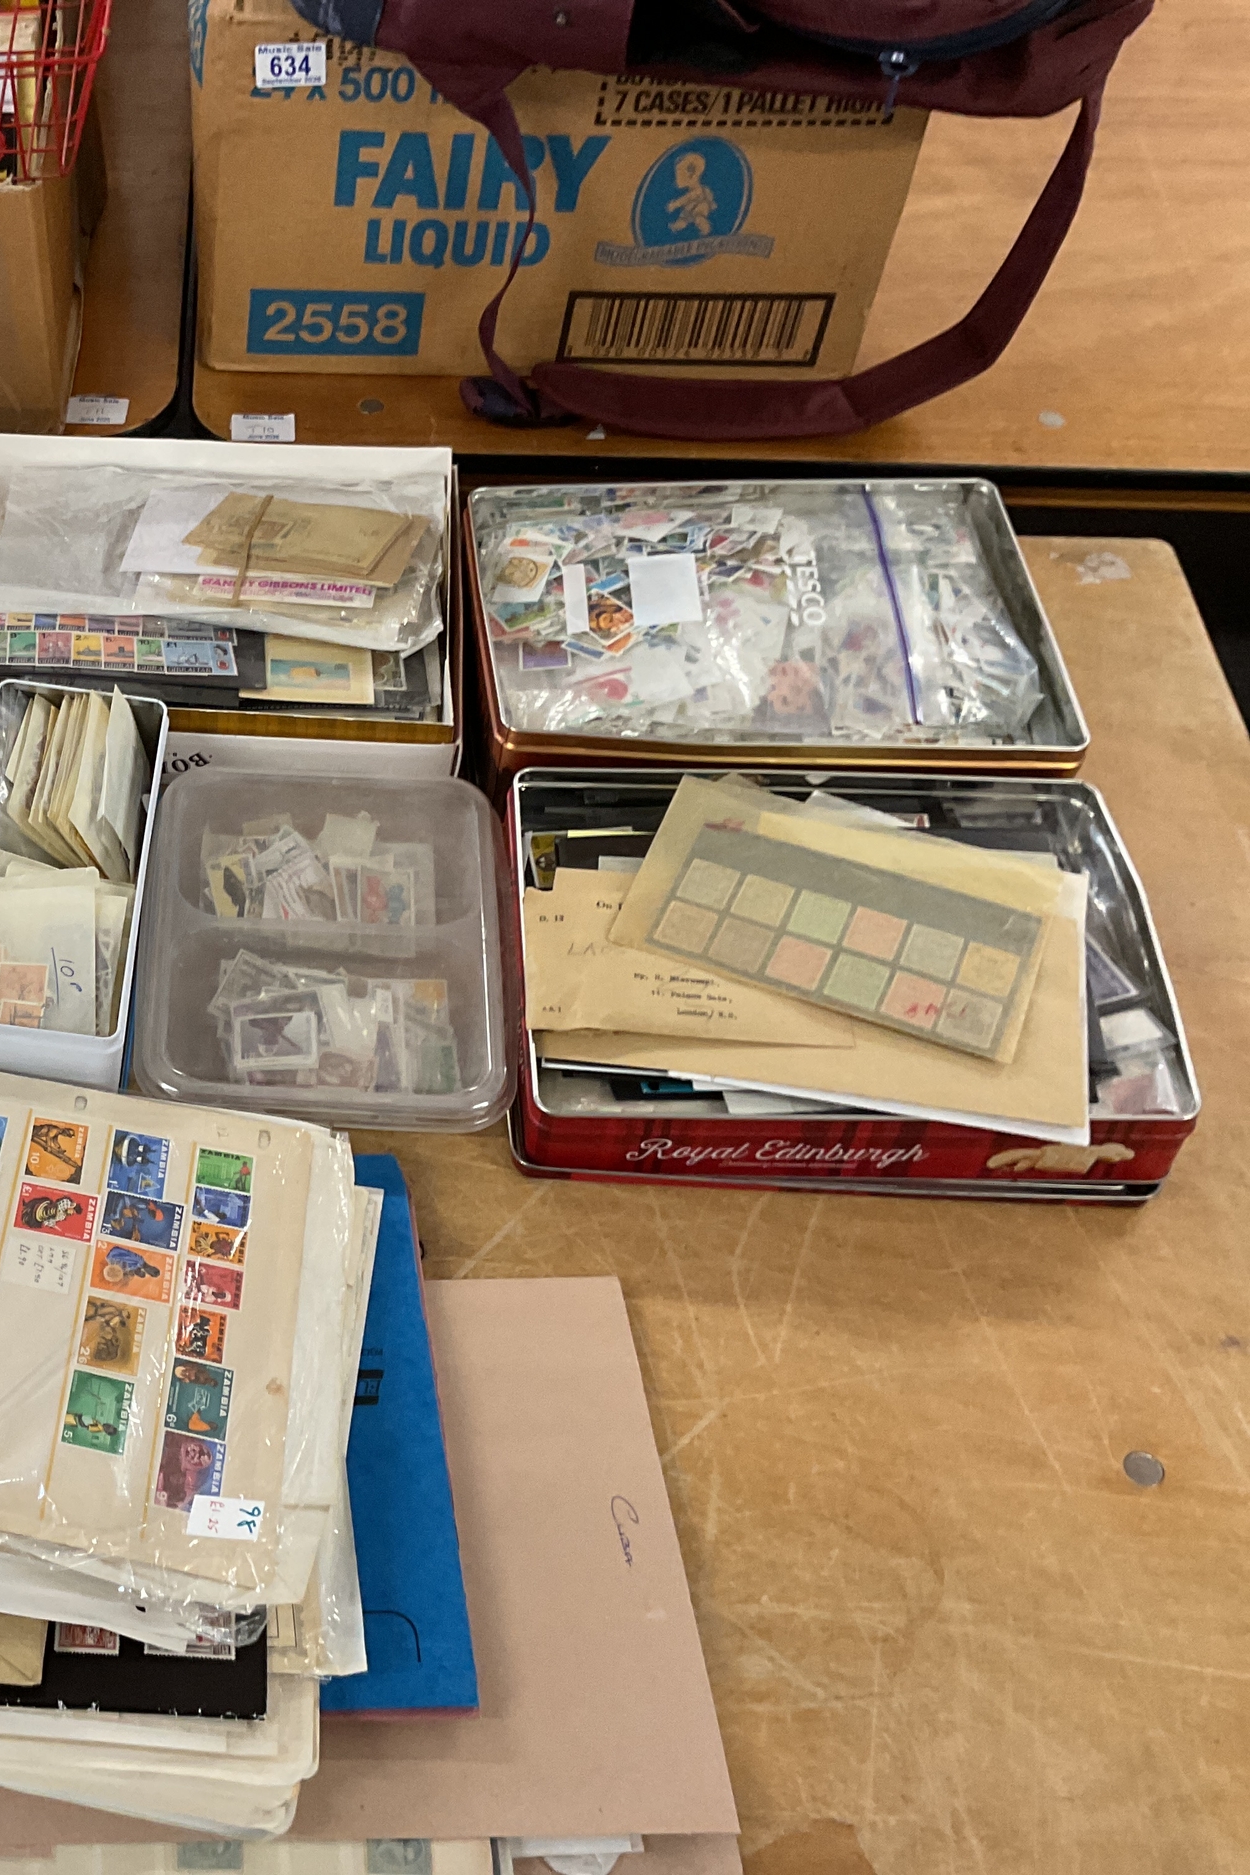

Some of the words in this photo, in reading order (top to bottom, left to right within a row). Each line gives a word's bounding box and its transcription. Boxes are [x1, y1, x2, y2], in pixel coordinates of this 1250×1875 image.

[270, 54, 311, 77] 634
[338, 67, 416, 104] 500
[615, 91, 630, 113] 7
[333, 130, 611, 213] FAIRY
[364, 218, 551, 269] LIQUID
[262, 301, 409, 345] 2558
[202, 577, 254, 588] STANY
[258, 579, 318, 591] GIBBONS
[74, 1126, 85, 1159] ZAMBIA
[157, 1139, 170, 1179] ZAMBIA
[200, 1149, 242, 1161] ZAMBIA
[626, 1138, 750, 1167] Royal
[755, 1140, 930, 1169] Edinburgh
[82, 1197, 97, 1241] ZAMBIA
[169, 1206, 184, 1249] ZAMBIA
[161, 1256, 173, 1300] ZAMBIA
[133, 1308, 146, 1354] ZAMBIA
[118, 1383, 134, 1431] ZAMBIA
[219, 1369, 233, 1418] ZAMBIA
[210, 1443, 225, 1494] ZAMBIA
[236, 1506, 261, 1534] 98
